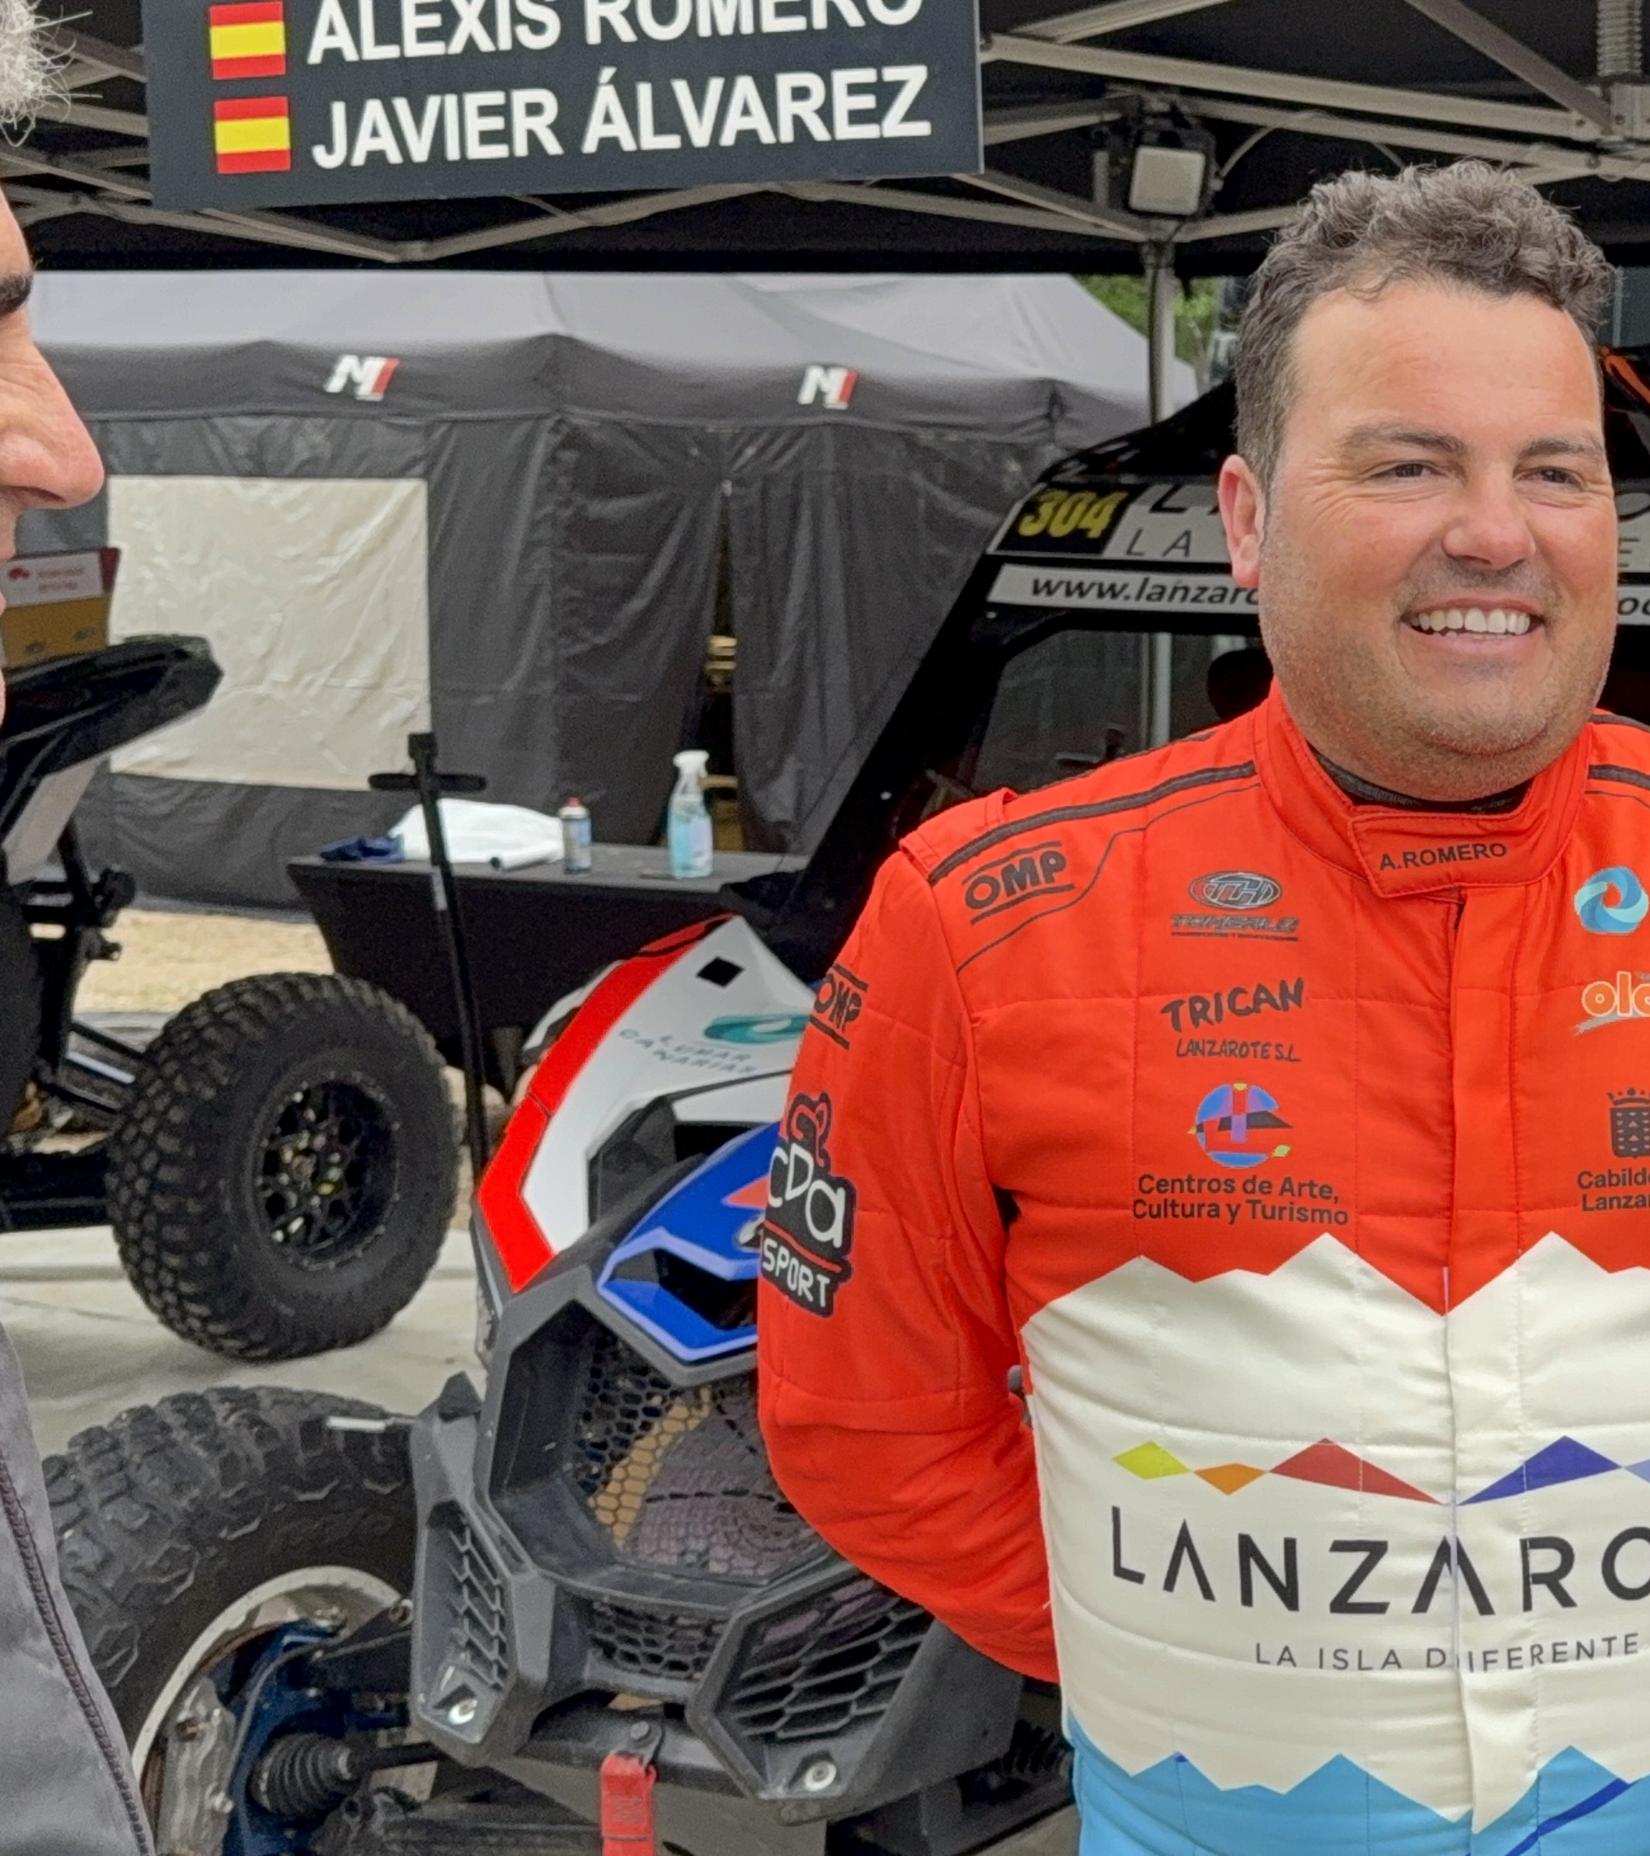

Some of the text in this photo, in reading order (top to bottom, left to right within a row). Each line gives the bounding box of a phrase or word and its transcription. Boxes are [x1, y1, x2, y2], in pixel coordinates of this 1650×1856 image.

[306, 0, 562, 64] ALEXIS
[311, 64, 932, 170] JAVIER ÁLVAREZ
[1018, 489, 1129, 539] 304
[1126, 528, 1192, 557] LA
[964, 849, 1068, 910] OMP
[1379, 842, 1508, 871] A.ROMERO
[813, 973, 863, 1032] OMP
[1160, 977, 1305, 1032] TRICAN
[1175, 1038, 1271, 1060] LANZAROTE
[1132, 1199, 1348, 1225] Cultura y Turismo
[1138, 1173, 1339, 1203] Centros de Arte,
[762, 1236, 831, 1307] SPORT
[1256, 1643, 1297, 1668] LA
[1318, 1647, 1403, 1671] ISLA
